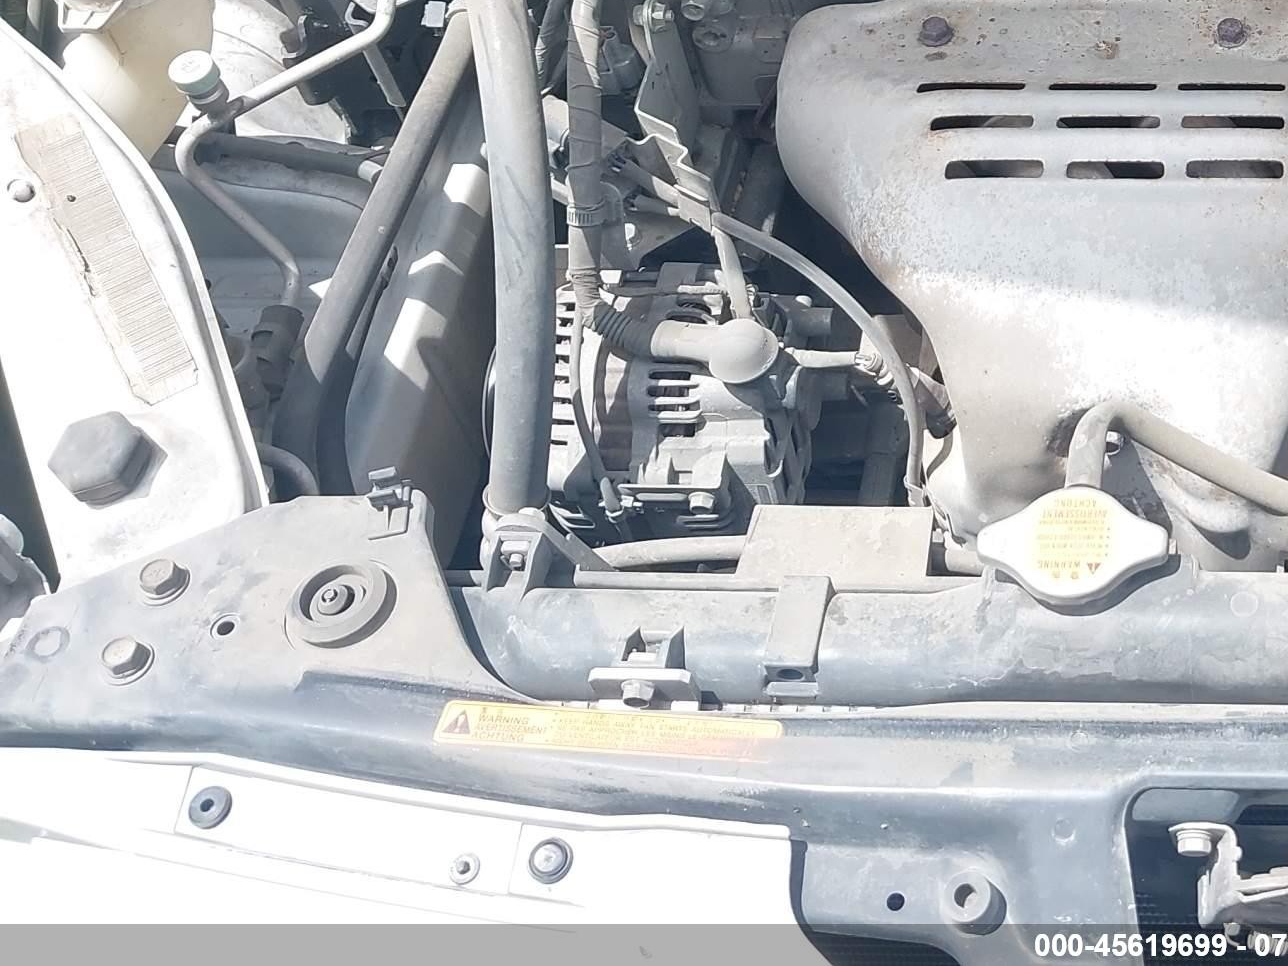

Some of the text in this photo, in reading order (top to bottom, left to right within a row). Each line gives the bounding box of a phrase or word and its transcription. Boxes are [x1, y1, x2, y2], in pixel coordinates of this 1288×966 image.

[1037, 559, 1081, 569] WARNING
[478, 714, 530, 726] WARNING
[474, 722, 548, 735] AVERTISSEMENT
[471, 731, 524, 742] ACHTUNG
